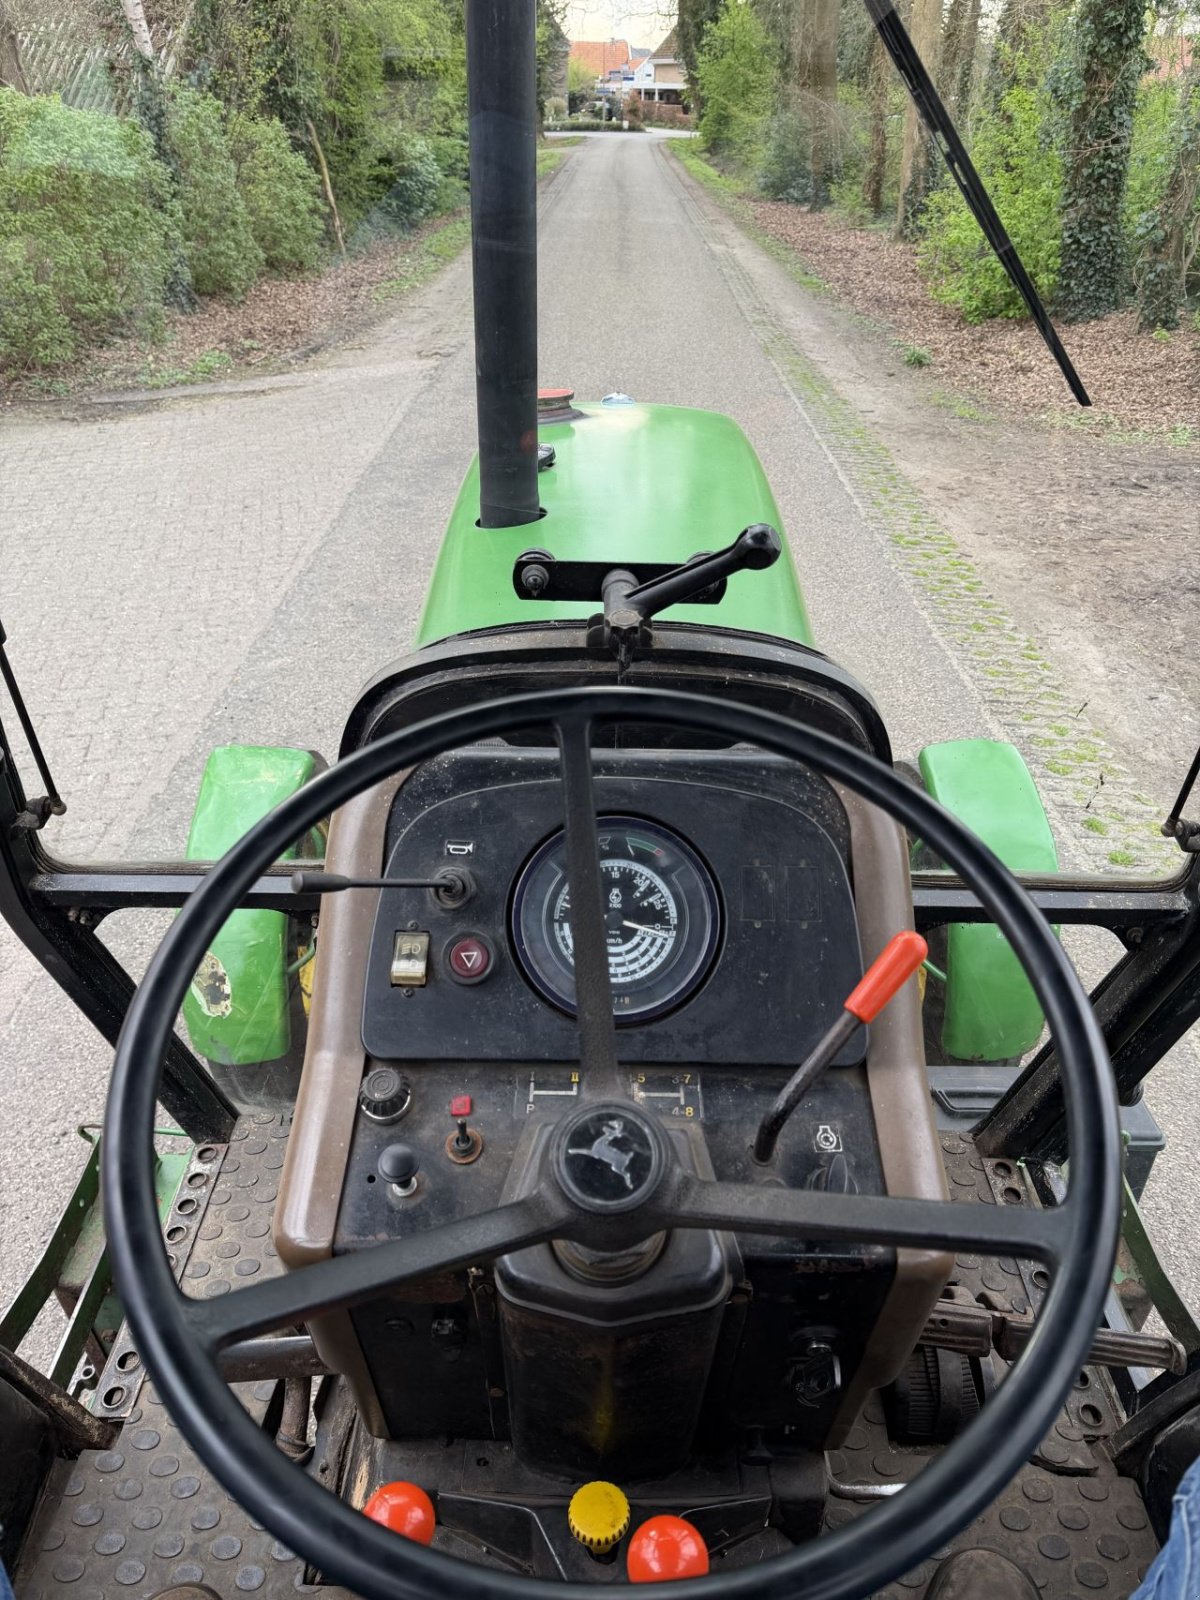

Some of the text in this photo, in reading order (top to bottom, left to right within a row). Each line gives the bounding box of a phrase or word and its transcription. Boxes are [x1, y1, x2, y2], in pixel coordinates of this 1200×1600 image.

[633, 877, 644, 886] 20
[653, 899, 662, 910] 25
[571, 1071, 579, 1082] II
[526, 1104, 535, 1114] P
